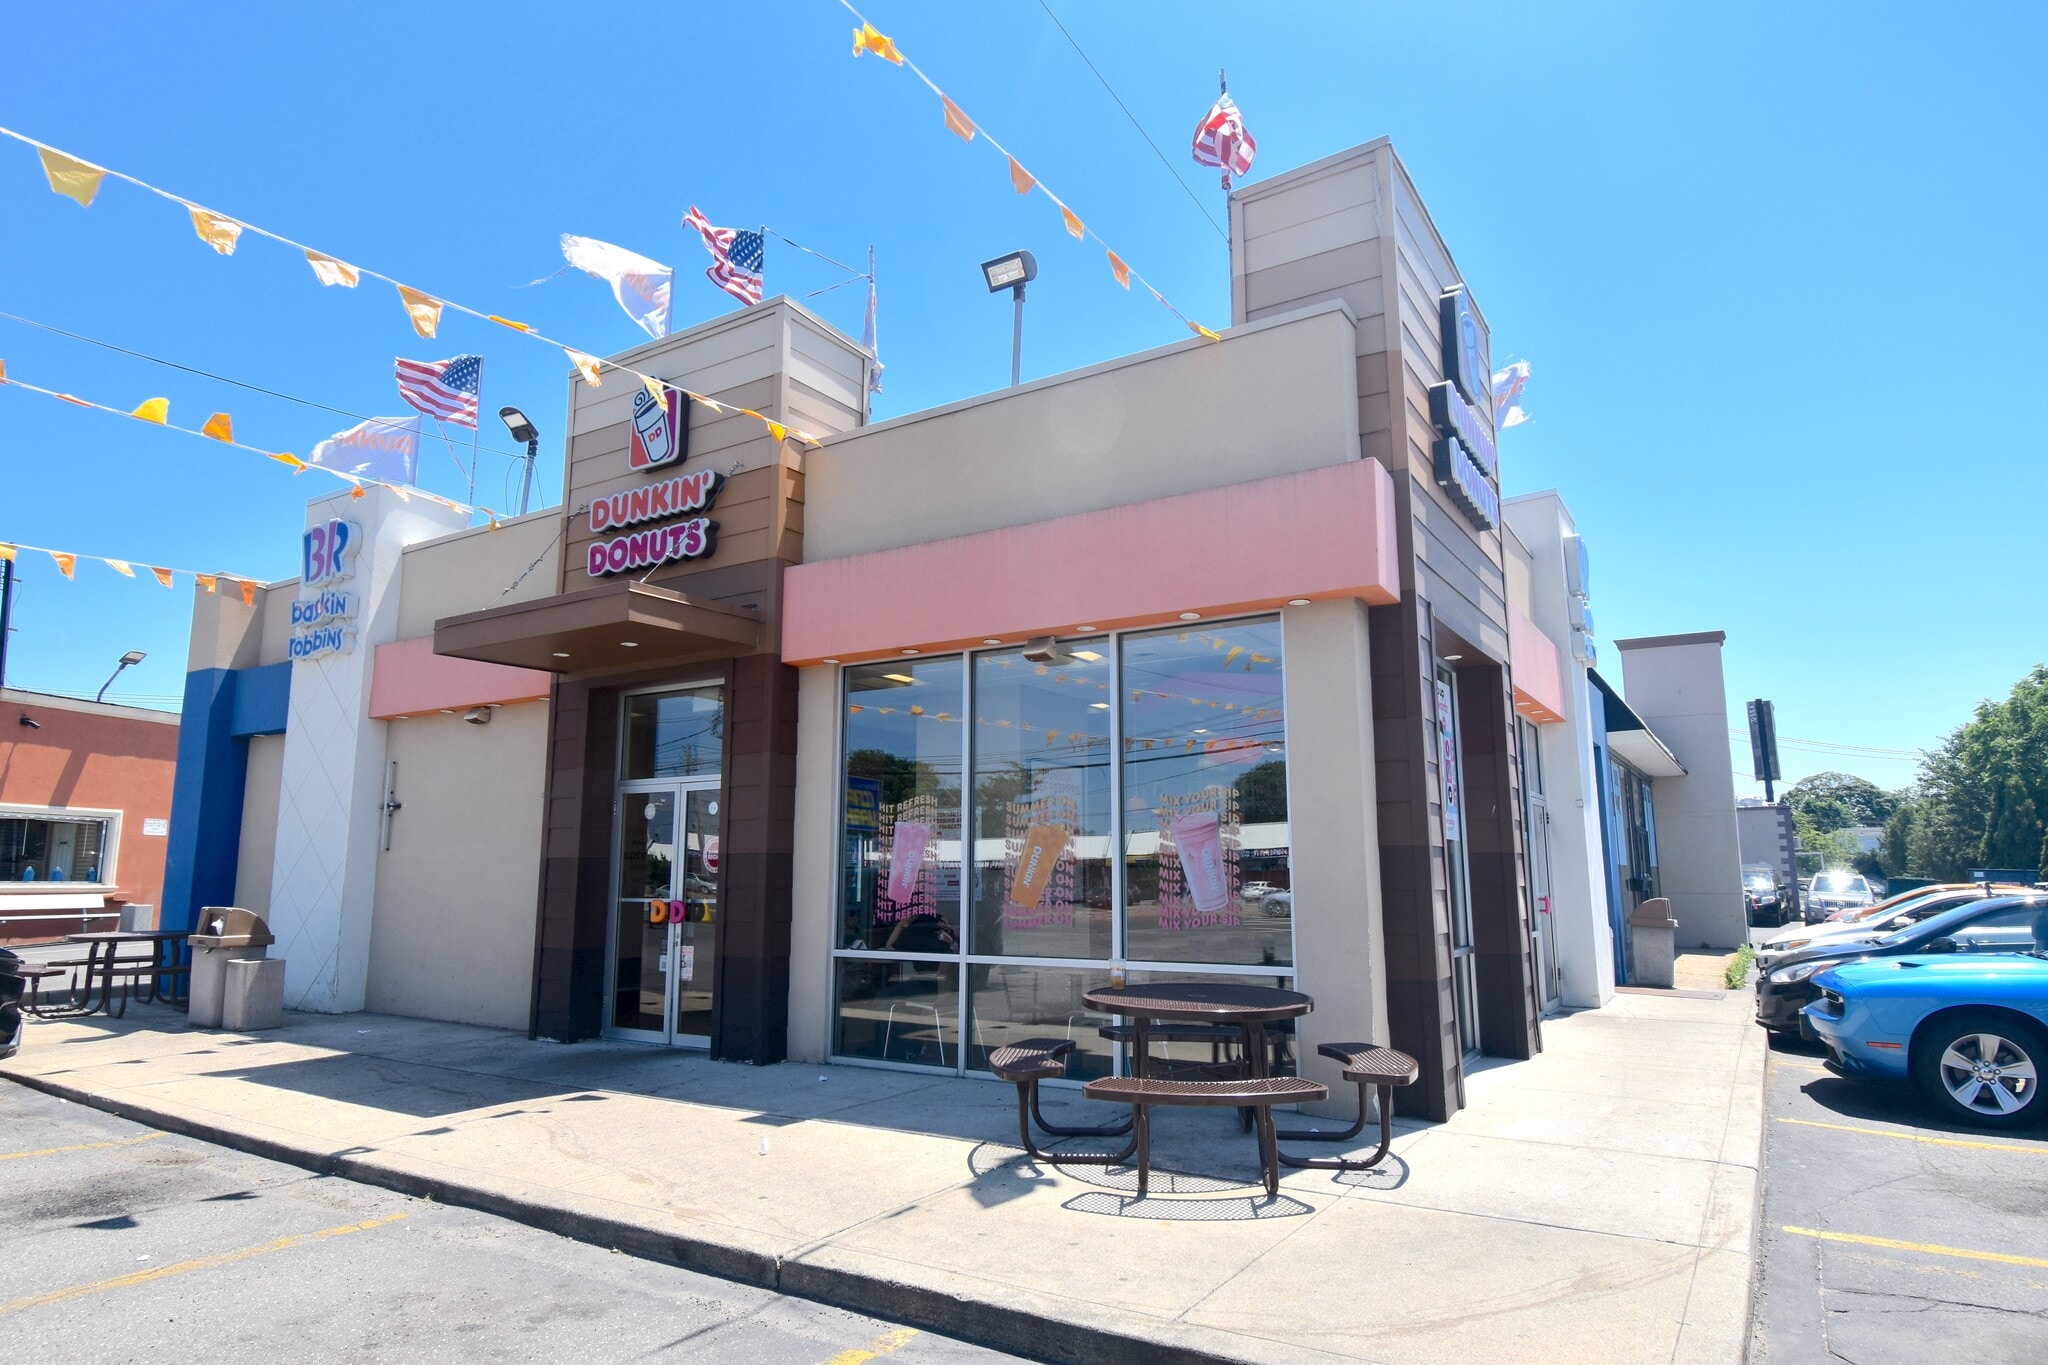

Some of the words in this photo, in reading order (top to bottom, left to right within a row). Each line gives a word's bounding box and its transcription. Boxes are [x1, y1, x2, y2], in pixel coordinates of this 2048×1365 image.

[648, 426, 662, 443] DD
[592, 472, 710, 529] DUNKIN'
[303, 521, 348, 582] BR
[589, 520, 702, 575] DONUTS
[1184, 787, 1217, 804] YOUR
[1221, 786, 1239, 799] SIP
[879, 802, 894, 813] HIT
[897, 795, 937, 812] REFRESH
[1222, 799, 1239, 811] SIP
[879, 813, 894, 824] HIT
[1221, 811, 1240, 824] SIP
[879, 824, 894, 834] HIT
[1159, 855, 1180, 868] MIX
[1221, 849, 1240, 862] SIP
[878, 867, 887, 878] HI
[902, 850, 915, 889] DUNKIN'
[1023, 845, 1042, 888] DUNKIN'
[1056, 860, 1073, 876] ON
[1159, 867, 1180, 880] MIX
[878, 877, 887, 889] HI
[1056, 873, 1073, 888] ON
[1159, 880, 1180, 893] MIX
[878, 888, 887, 899] HI
[1056, 886, 1073, 901] ON
[1159, 892, 1180, 905] MIX
[878, 899, 893, 910] HIT
[1159, 904, 1180, 918] MIX
[877, 909, 893, 921] HIT
[895, 905, 937, 921] REFRESH
[1159, 917, 1180, 930] MIX
[1184, 914, 1218, 929] YOUR
[1222, 914, 1240, 927] SIP
